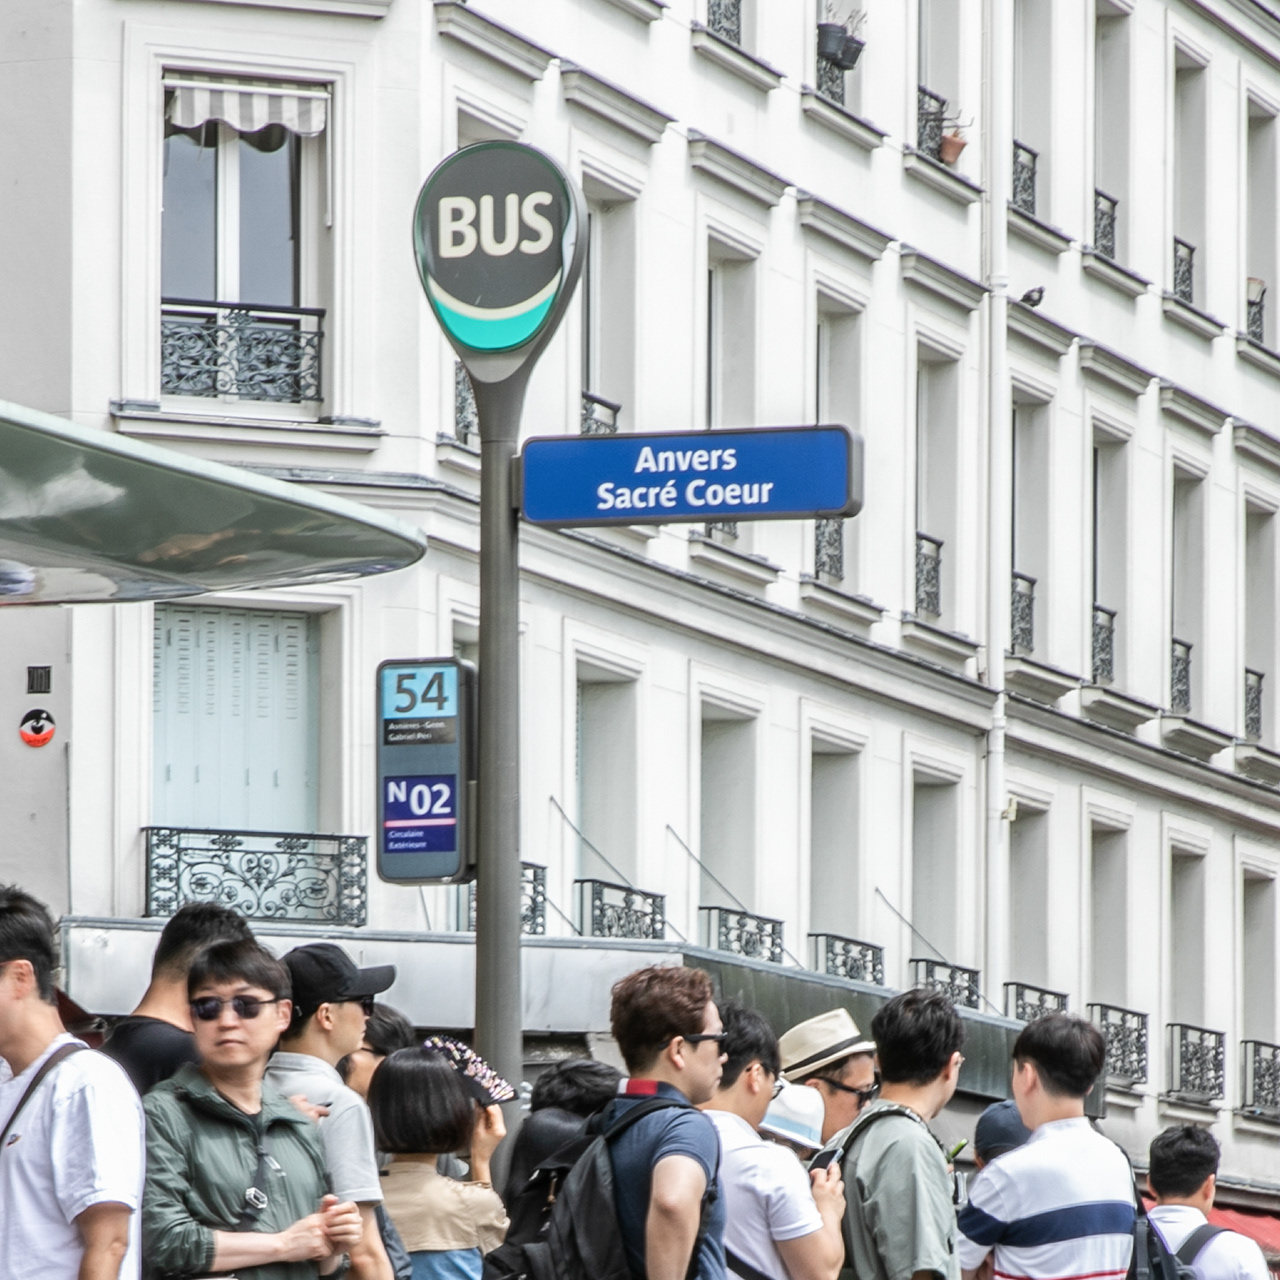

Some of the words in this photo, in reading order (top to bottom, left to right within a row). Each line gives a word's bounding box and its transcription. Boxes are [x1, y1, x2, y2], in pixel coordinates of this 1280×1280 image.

[439, 191, 554, 259] BUS
[634, 446, 738, 474] Anvers
[596, 479, 678, 510] Sacré
[685, 479, 774, 507] Coeur
[394, 671, 450, 713] 54
[388, 830, 424, 839] Circulaire
[388, 841, 427, 850] Extérieure
